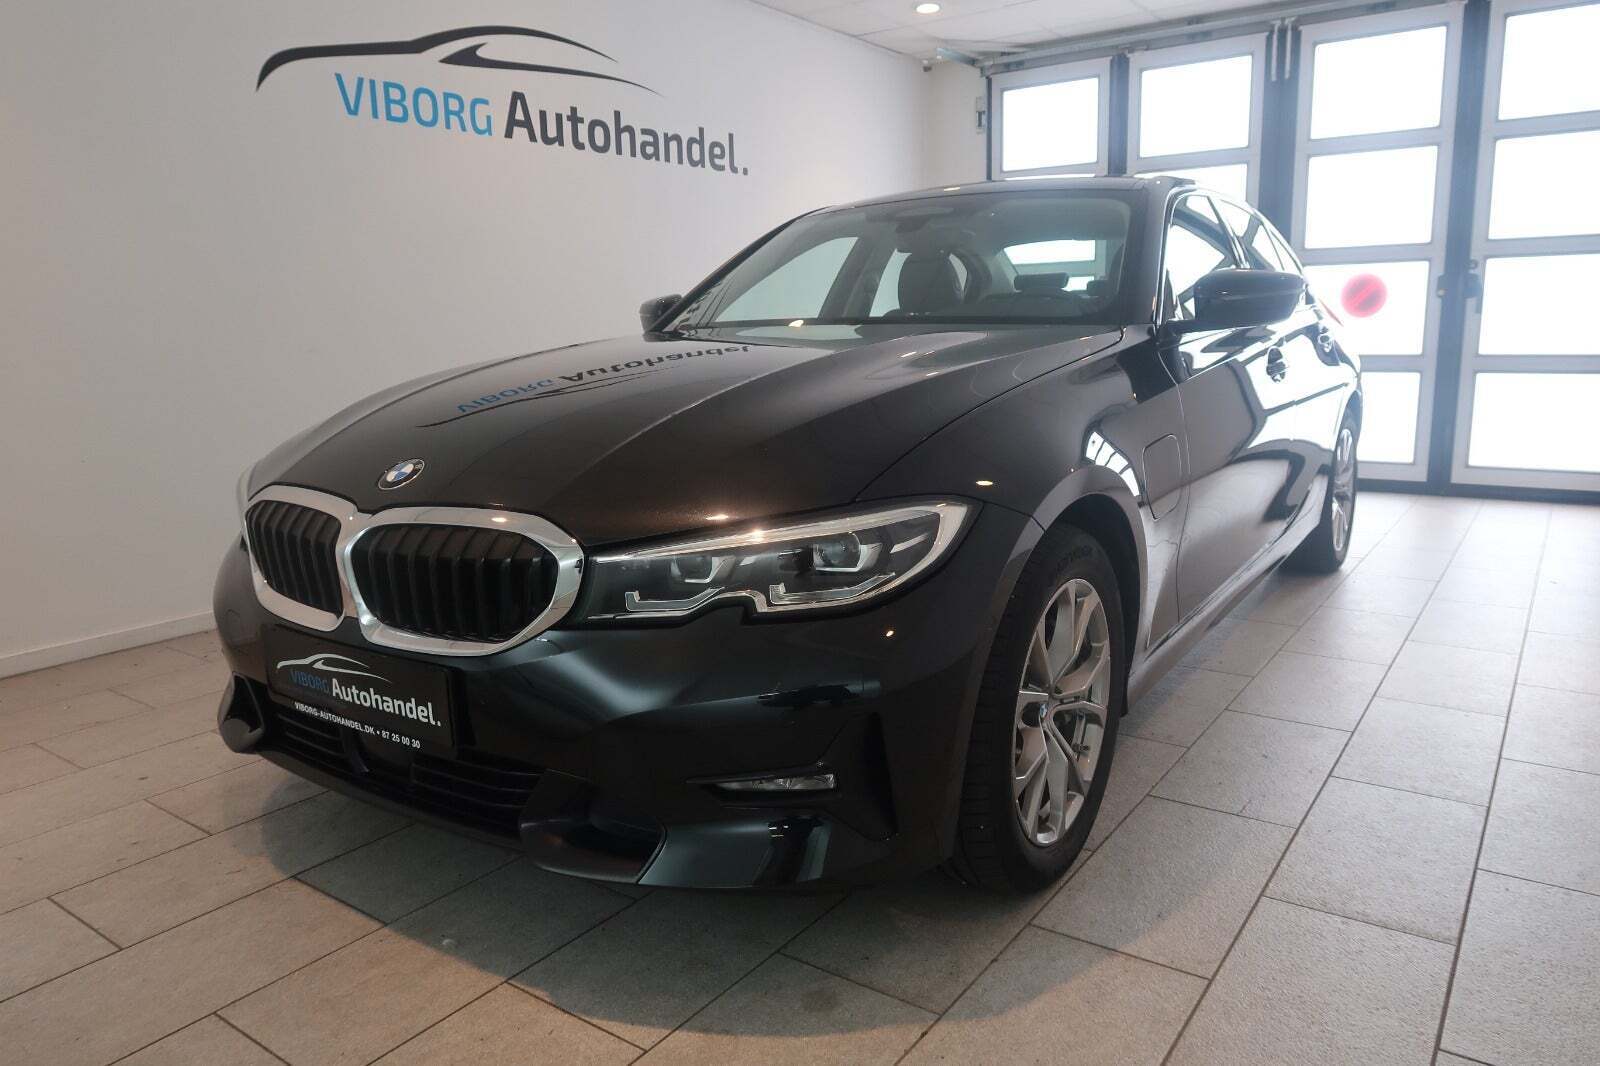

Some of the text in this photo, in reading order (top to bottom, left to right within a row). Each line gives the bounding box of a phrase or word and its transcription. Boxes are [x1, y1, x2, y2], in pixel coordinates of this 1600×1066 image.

[334, 72, 749, 176] VIBORG Autohandel.
[290, 669, 442, 727] VIBORG Autohandel.
[294, 701, 421, 749] VIBORG-AUTOHANDEL.DK 87 25 00 30
